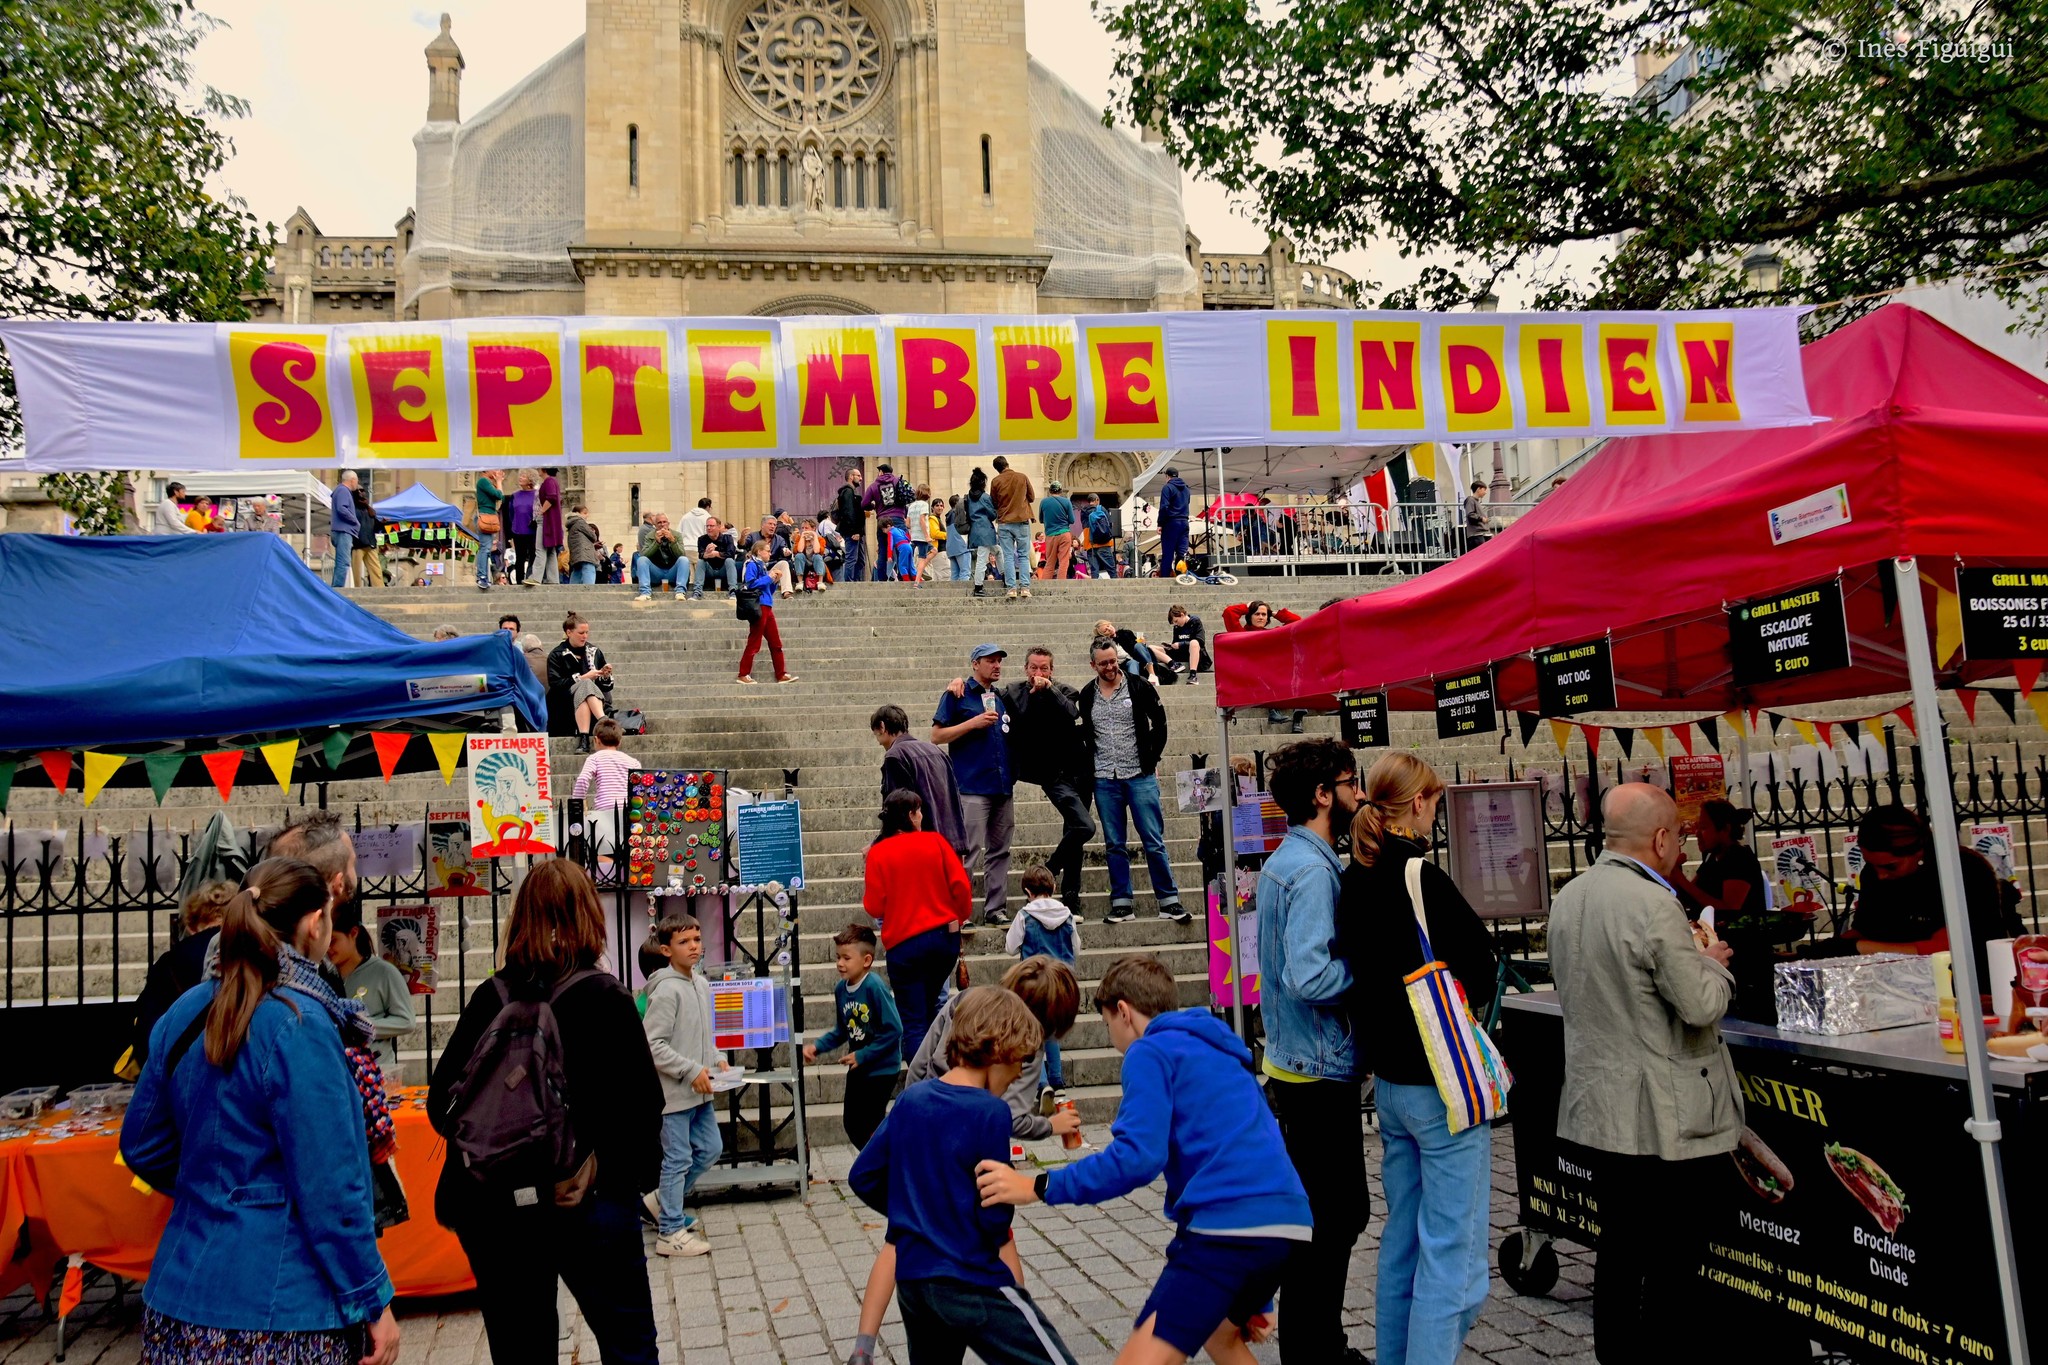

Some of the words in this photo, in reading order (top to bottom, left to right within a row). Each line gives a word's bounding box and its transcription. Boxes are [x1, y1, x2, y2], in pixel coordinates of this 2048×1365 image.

[251, 338, 1159, 444] SEPTEMBRE
[1288, 335, 1733, 418] INDIEN
[1992, 574, 2030, 587] GRILL
[1751, 602, 1779, 618] GRILL
[1780, 591, 1821, 611] MASTER
[1969, 597, 2039, 611] BOISSONES
[1760, 613, 1813, 637] ESCALOPE
[2002, 615, 2018, 628] 25
[2019, 615, 2031, 628] cl
[1767, 632, 1810, 653] NATURE
[2018, 636, 2028, 651] 3
[1549, 651, 1569, 664] GRILL
[1569, 645, 1596, 660] MASTER
[1775, 658, 1783, 673] 5
[1784, 656, 1810, 671] euro
[1445, 681, 1460, 691] GRILL
[1460, 675, 1481, 687] MASTER
[1557, 672, 1573, 686] HOT
[1574, 669, 1591, 683] DOG
[1349, 698, 1361, 707] GRILL
[1361, 696, 1378, 705] MASTER
[1565, 694, 1571, 706] 5
[1571, 693, 1589, 705] euro
[1351, 708, 1377, 719] BROCHETTE
[1450, 708, 1457, 717] 25
[1465, 705, 1471, 715] 33
[1457, 721, 1461, 731] 3
[1461, 720, 1475, 730] euro
[470, 737, 545, 754] SEPTEMBRE
[535, 748, 553, 802] INDIEN
[377, 906, 436, 919] SEPTEMBRE
[1533, 1174, 1557, 1196] MENU
[1561, 1185, 1568, 1200] L
[1577, 1191, 1583, 1206] 1
[1529, 1195, 1551, 1217] MENU
[1556, 1206, 1568, 1223] XL
[1569, 1215, 1577, 1223] =
[1578, 1215, 1585, 1230] 2
[1739, 1210, 1801, 1245] Merguez
[1853, 1226, 1916, 1264] Brochette
[1869, 1256, 1909, 1287] Dinde
[1709, 1241, 1775, 1275] caramelise
[1777, 1264, 1783, 1276] +
[1787, 1268, 1812, 1289] une
[1816, 1274, 1868, 1310] boisson
[1871, 1299, 1888, 1318] au
[1892, 1305, 1930, 1335] choix
[1932, 1324, 1941, 1335] =
[1944, 1324, 1954, 1345] 7
[1960, 1334, 1994, 1362] euro
[1708, 1267, 1772, 1303] caramelise
[1776, 1291, 1785, 1304] +
[1787, 1296, 1812, 1318] une
[1815, 1303, 1865, 1340] boisson
[1868, 1329, 1887, 1349] au
[1891, 1337, 1928, 1365] choix
